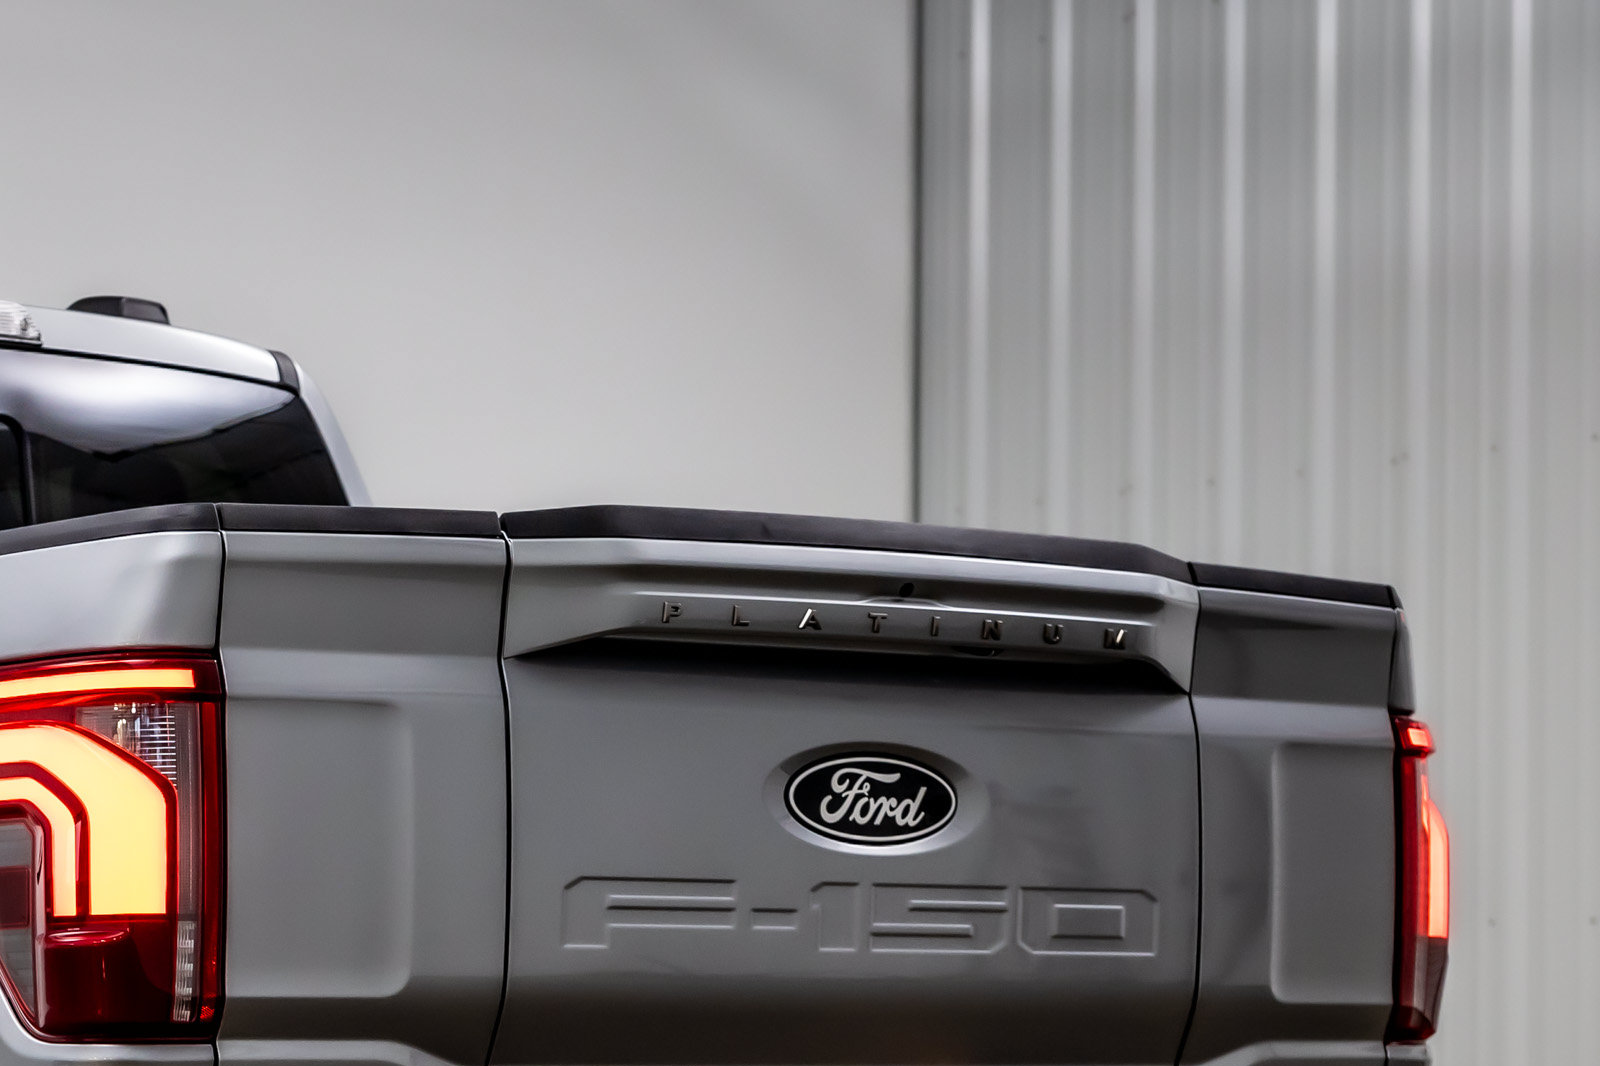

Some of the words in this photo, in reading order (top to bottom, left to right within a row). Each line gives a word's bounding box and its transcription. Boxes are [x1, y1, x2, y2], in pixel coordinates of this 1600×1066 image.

[660, 601, 1127, 651] PLATINUM
[818, 766, 928, 829] Ford
[562, 874, 1159, 958] F-150
